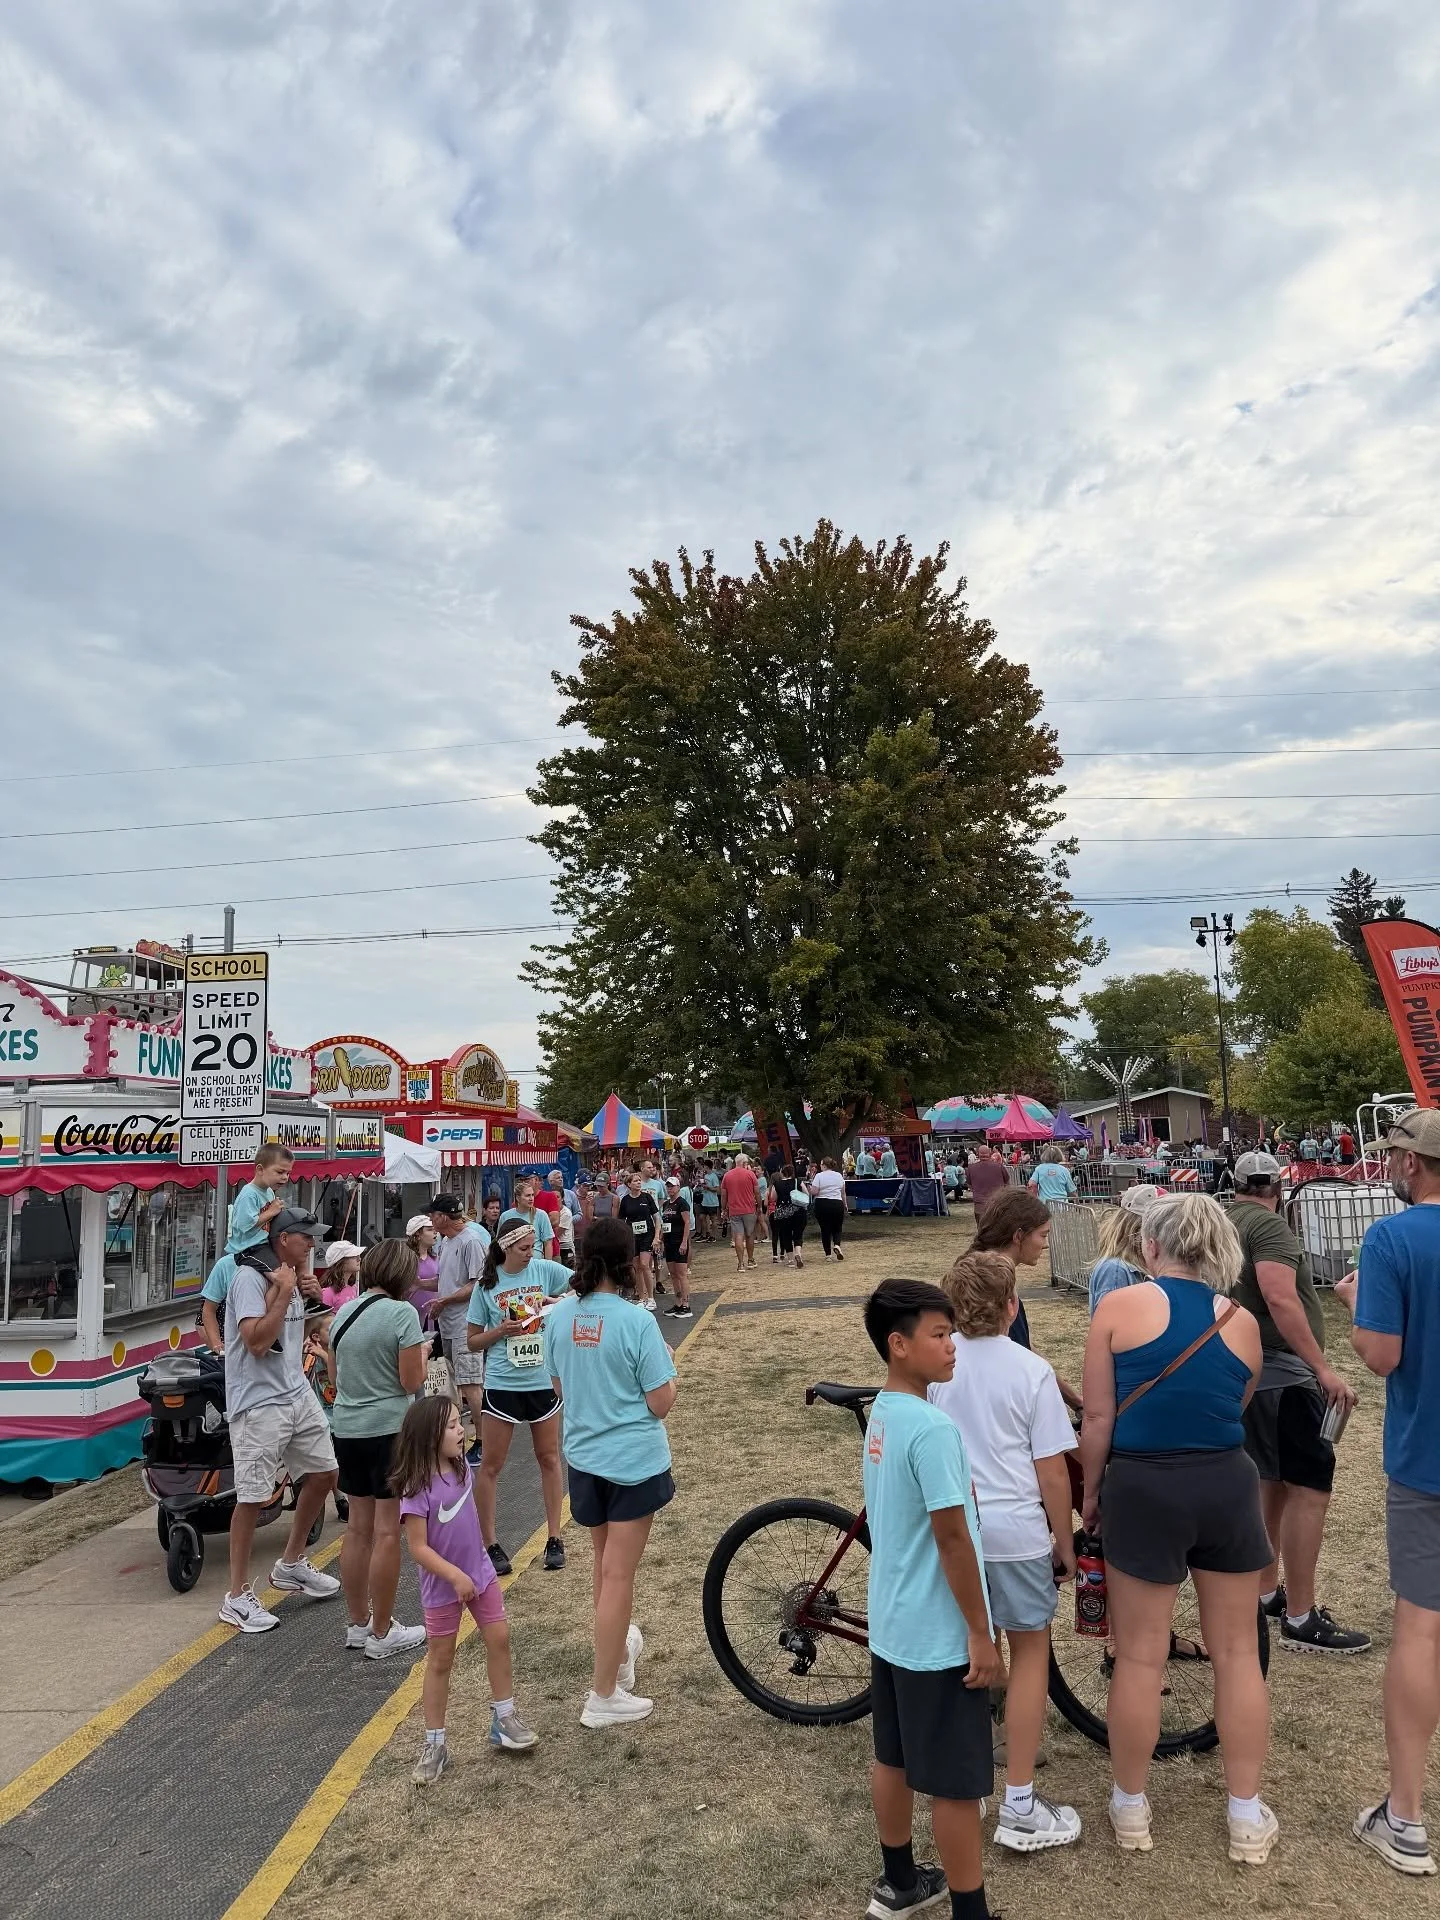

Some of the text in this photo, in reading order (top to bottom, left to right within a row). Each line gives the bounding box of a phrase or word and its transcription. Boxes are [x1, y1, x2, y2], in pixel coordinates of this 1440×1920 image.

[190, 959, 263, 976] SCHOOL
[1400, 955, 1440, 974] Libby's
[192, 992, 260, 1009] SPEED
[198, 1012, 252, 1030] LIMIT
[191, 1032, 258, 1071] 20
[185, 1073, 262, 1087] ON SCHOOL DAYS
[351, 1064, 392, 1092] DOGS
[187, 1085, 260, 1098] WHEN CHILDREN
[193, 1096, 254, 1109] ARE PRESENT
[53, 1114, 180, 1157] Coca-Cola
[189, 1127, 216, 1139] CELL
[219, 1125, 254, 1138] PHONE
[277, 1123, 301, 1146] FUNNEL
[302, 1125, 321, 1148] CAKES
[440, 1128, 484, 1141] PEPSI
[689, 1134, 708, 1143] STOP
[212, 1138, 232, 1149] USE
[191, 1149, 251, 1161] PROHIBITED
[512, 1343, 540, 1357] 1440
